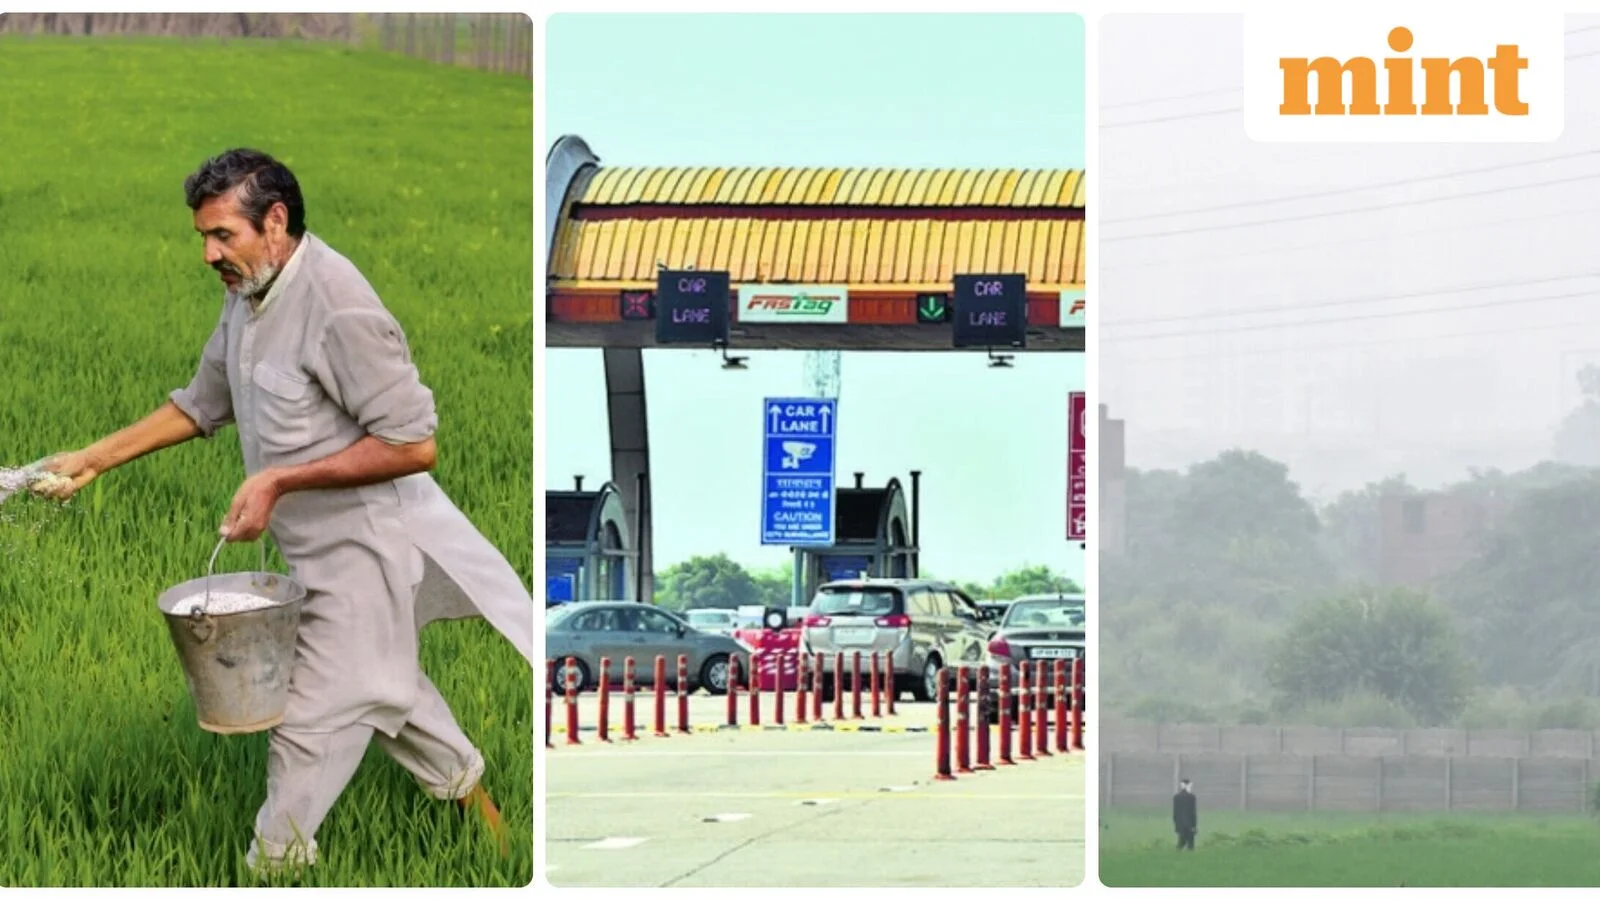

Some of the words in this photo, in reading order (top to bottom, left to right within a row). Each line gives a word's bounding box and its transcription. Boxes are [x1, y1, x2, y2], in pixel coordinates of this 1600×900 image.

[677, 278, 707, 293] CAR
[974, 281, 1004, 296] CAR
[672, 308, 710, 323] LANE
[969, 312, 1007, 326] LANE
[785, 405, 815, 417] CAR
[781, 421, 819, 433] LANE
[773, 511, 823, 522] CAUTION
